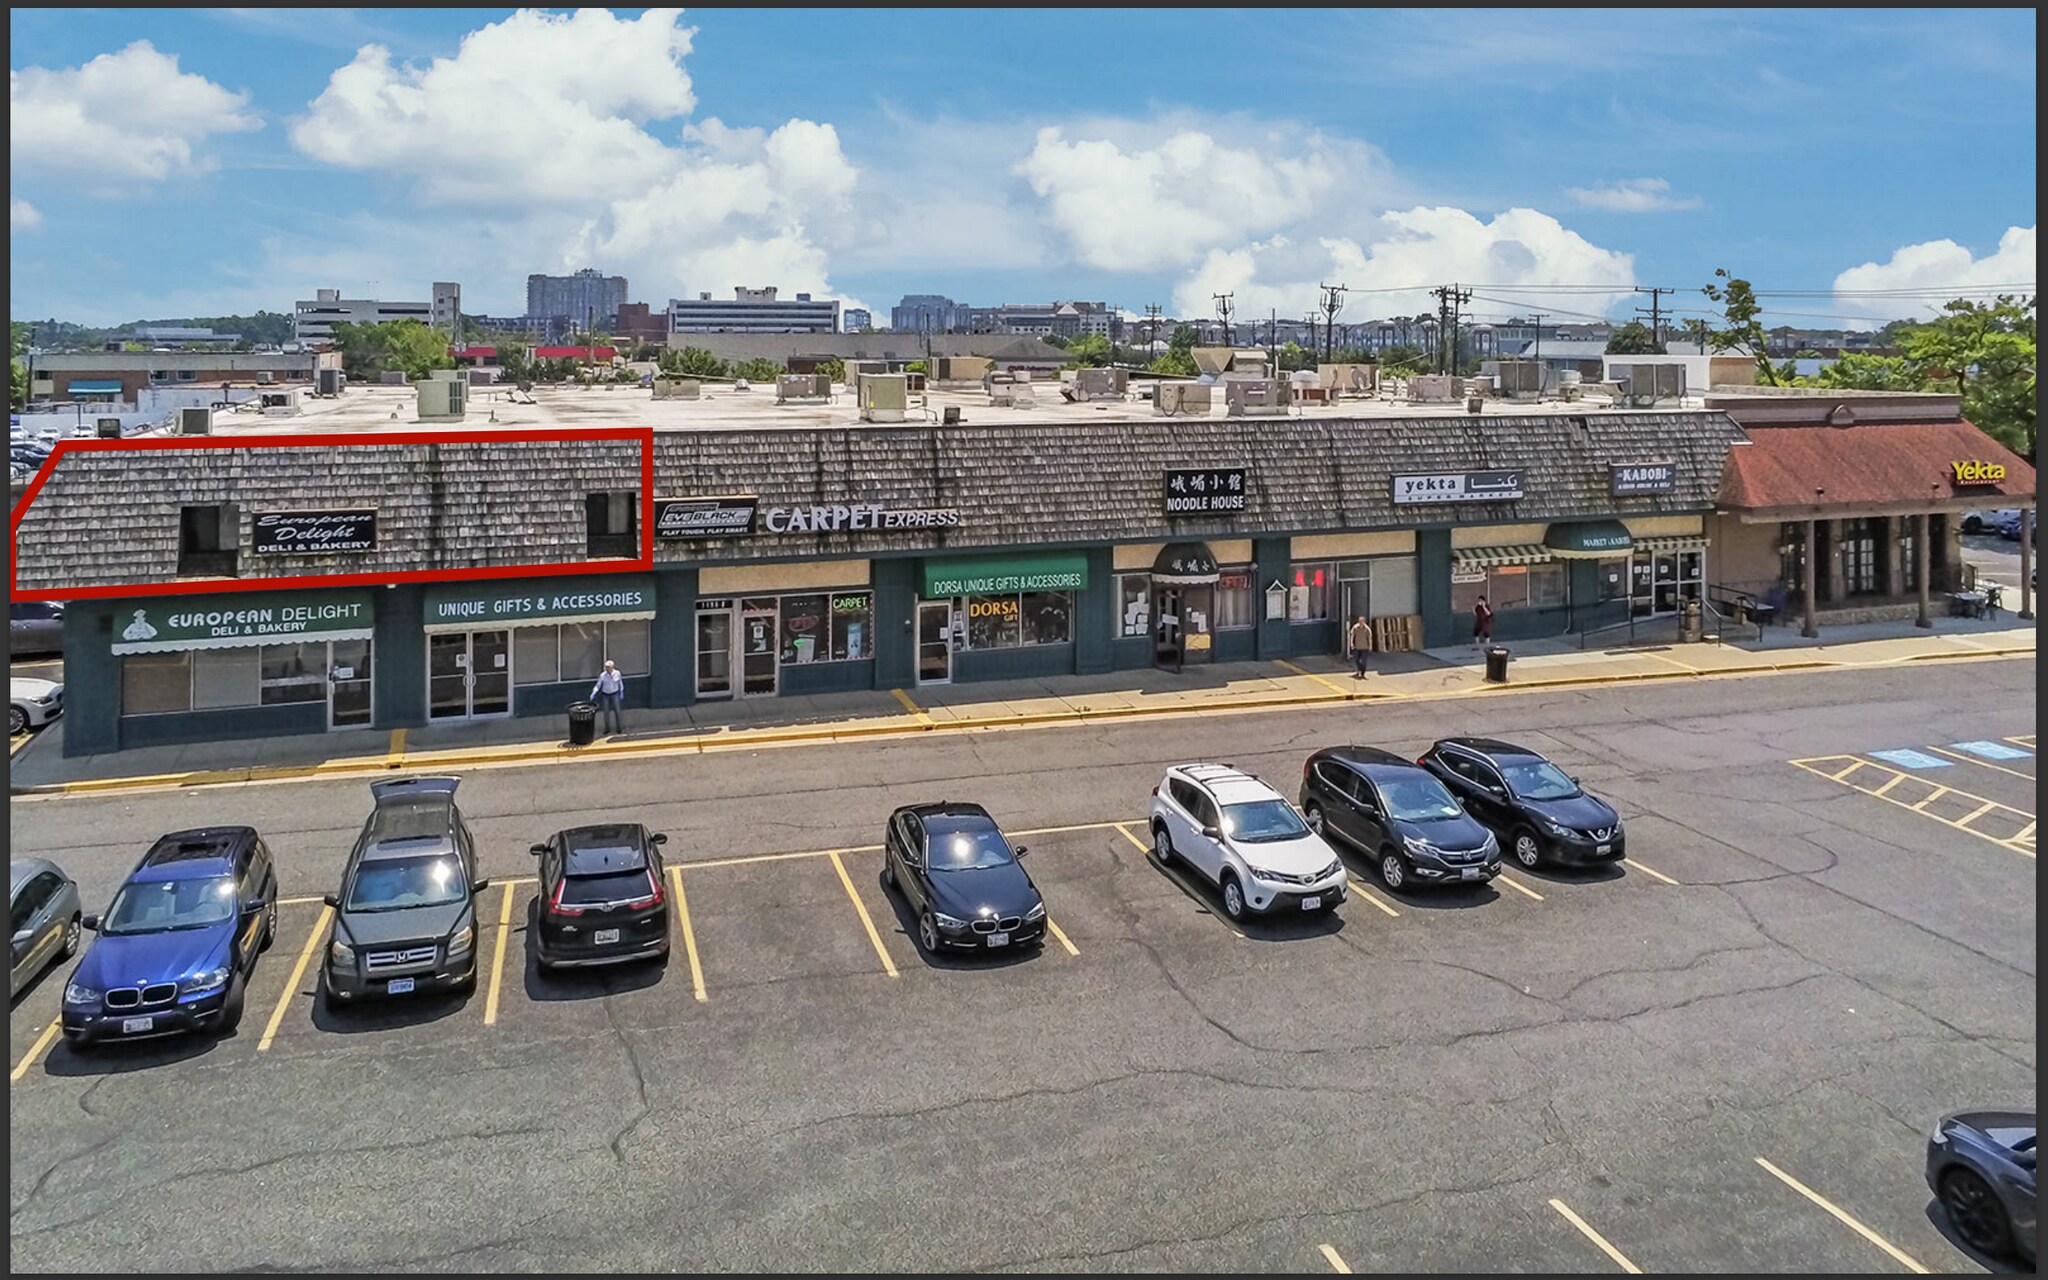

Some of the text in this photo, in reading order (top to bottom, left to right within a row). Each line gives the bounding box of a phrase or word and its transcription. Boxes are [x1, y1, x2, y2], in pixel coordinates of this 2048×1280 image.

[1622, 467, 1667, 481] KABOBI
[1952, 460, 2006, 480] Yekta
[1405, 477, 1456, 494] yekta
[1167, 495, 1244, 511] NOODLE HOUSE
[257, 515, 373, 526] European
[765, 503, 959, 533] CARPET EXPRESS
[275, 525, 355, 543] Delight
[258, 541, 371, 553] DELI & BAKERY
[934, 573, 1081, 595] DORSA UNIQUE GIFTS & ACCESSORIES
[438, 592, 642, 617] UNIQUE GIFTS & ACCESSORIES
[833, 596, 867, 609] CARPET
[970, 601, 1018, 617] DORSA
[168, 603, 361, 628] EUROPEAN DELIGHT
[1004, 614, 1018, 622] GIFT
[211, 621, 307, 636] DELI & BAKERY
